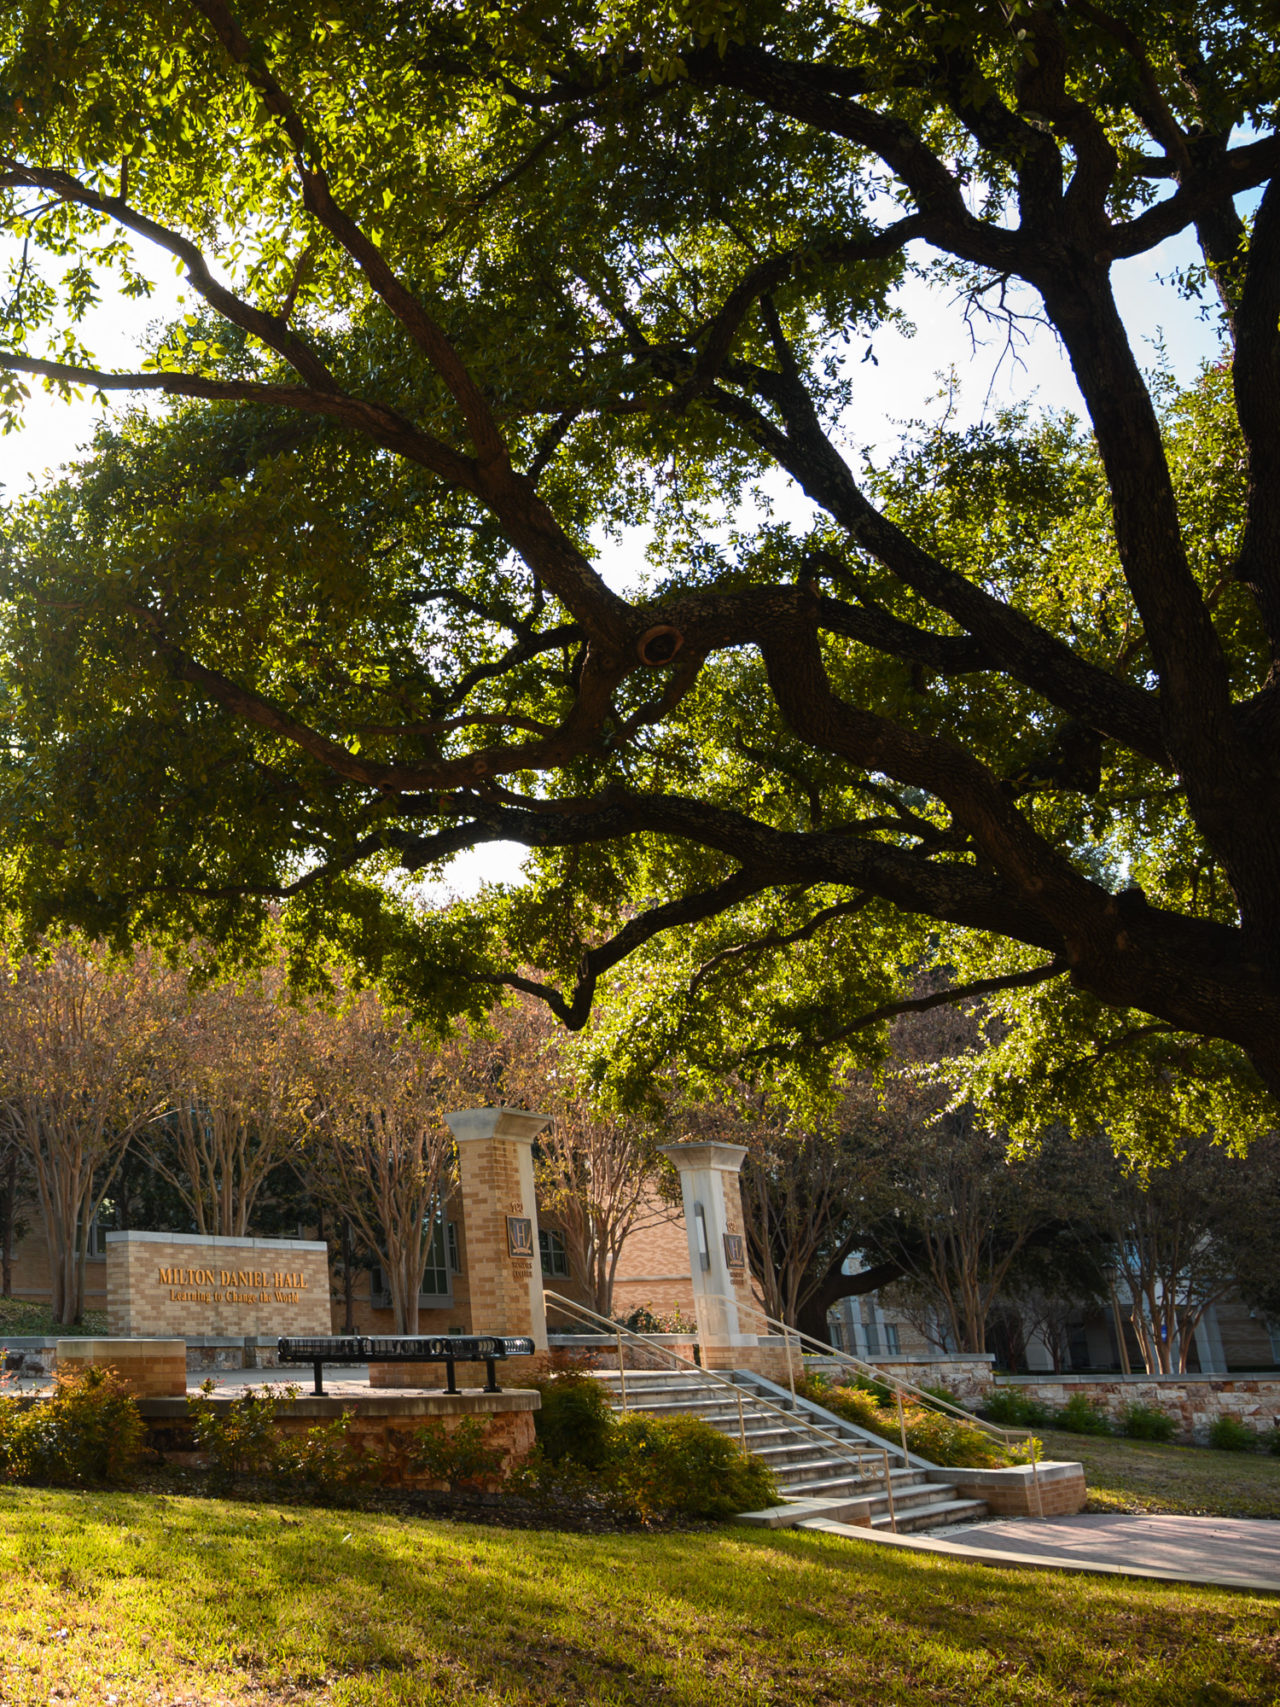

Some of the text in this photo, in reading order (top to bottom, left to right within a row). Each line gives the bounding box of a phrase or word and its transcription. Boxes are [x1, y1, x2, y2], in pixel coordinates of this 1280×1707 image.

[159, 1268, 308, 1289] MILTON DANIEL HALL
[170, 1289, 299, 1304] Learning to Change the World
